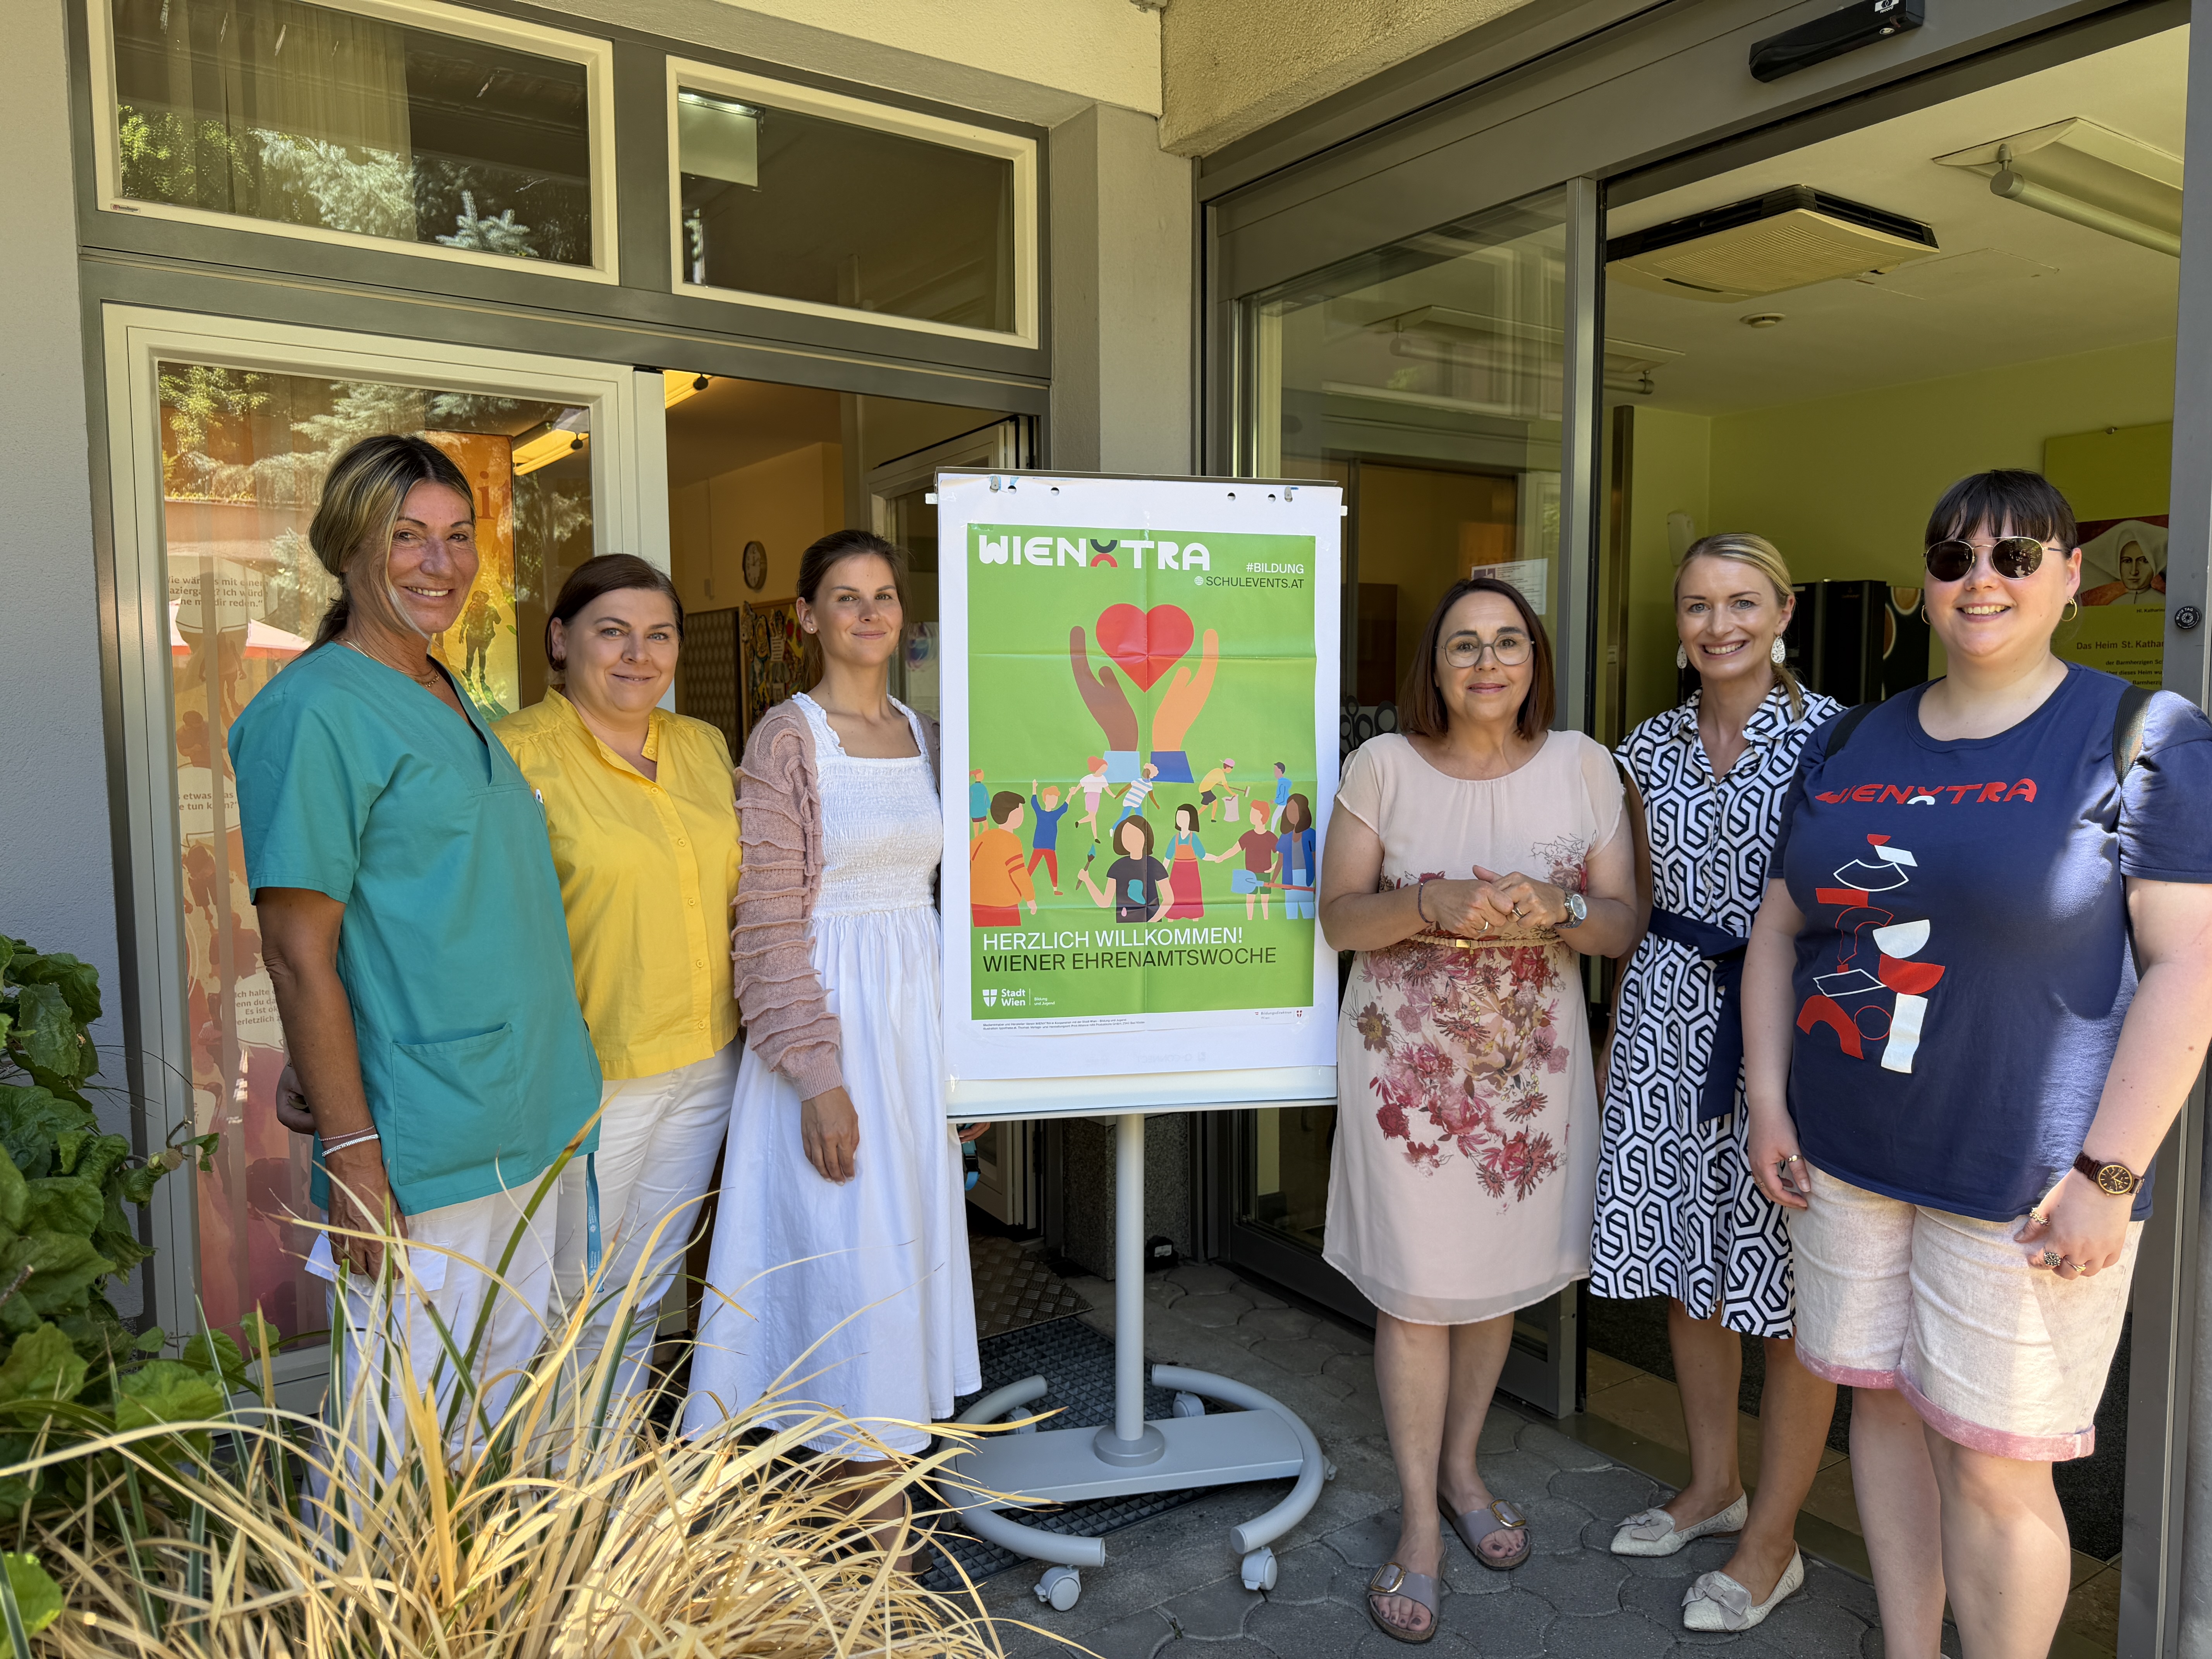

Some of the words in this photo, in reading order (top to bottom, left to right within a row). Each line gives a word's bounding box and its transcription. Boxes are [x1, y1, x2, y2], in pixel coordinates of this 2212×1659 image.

[979, 535, 1210, 571] WIENXTRA
[1246, 562, 1304, 574] #BILDUNG
[1206, 576, 1304, 589] SCHULEVENTS.AT
[983, 931, 1089, 951] HERZLICH
[1096, 927, 1242, 947] WILLKOMMEN!
[983, 953, 1065, 972] WIENER
[1073, 947, 1276, 970] EHRENAMTSWOCHE
[1001, 988, 1025, 997] Stadt
[1001, 998, 1025, 1006] Wien
